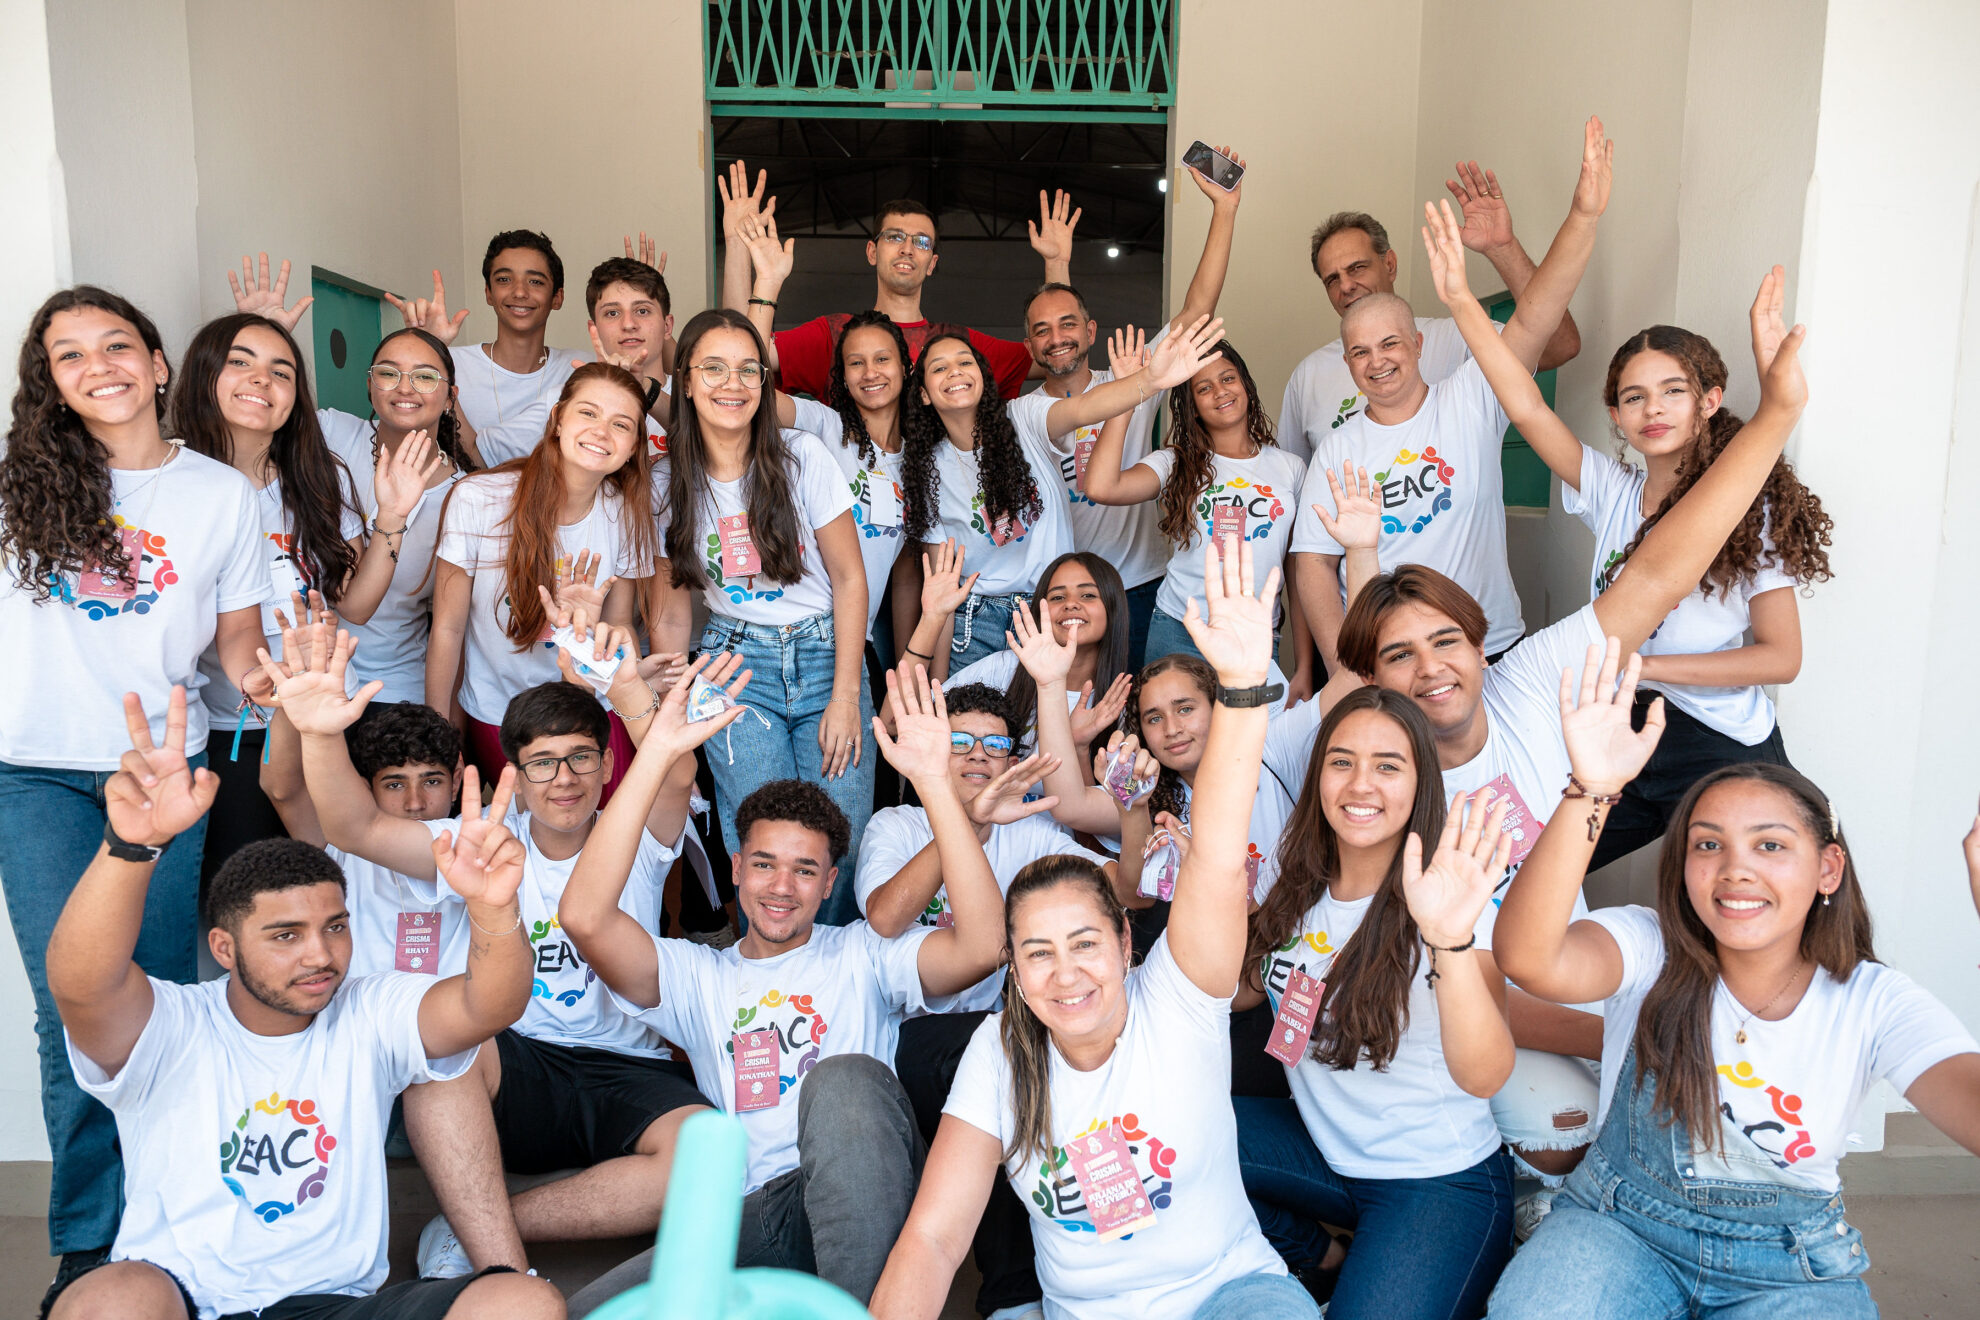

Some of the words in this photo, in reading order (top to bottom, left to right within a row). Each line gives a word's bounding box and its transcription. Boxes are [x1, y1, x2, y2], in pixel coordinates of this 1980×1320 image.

[1381, 464, 1439, 508] EAC
[405, 935, 431, 943] CRISMA
[537, 940, 588, 973] EA
[1288, 999, 1309, 1017] CRISMA
[1280, 1012, 1307, 1034] ISABELA
[744, 1057, 770, 1067] CRISMA
[739, 1071, 776, 1080] JONATHAN
[236, 1128, 315, 1176] EAC
[1089, 1161, 1123, 1182] CRISMA
[1088, 1180, 1125, 1203] JULIANA
[1094, 1186, 1137, 1208] OLIVEIRA
